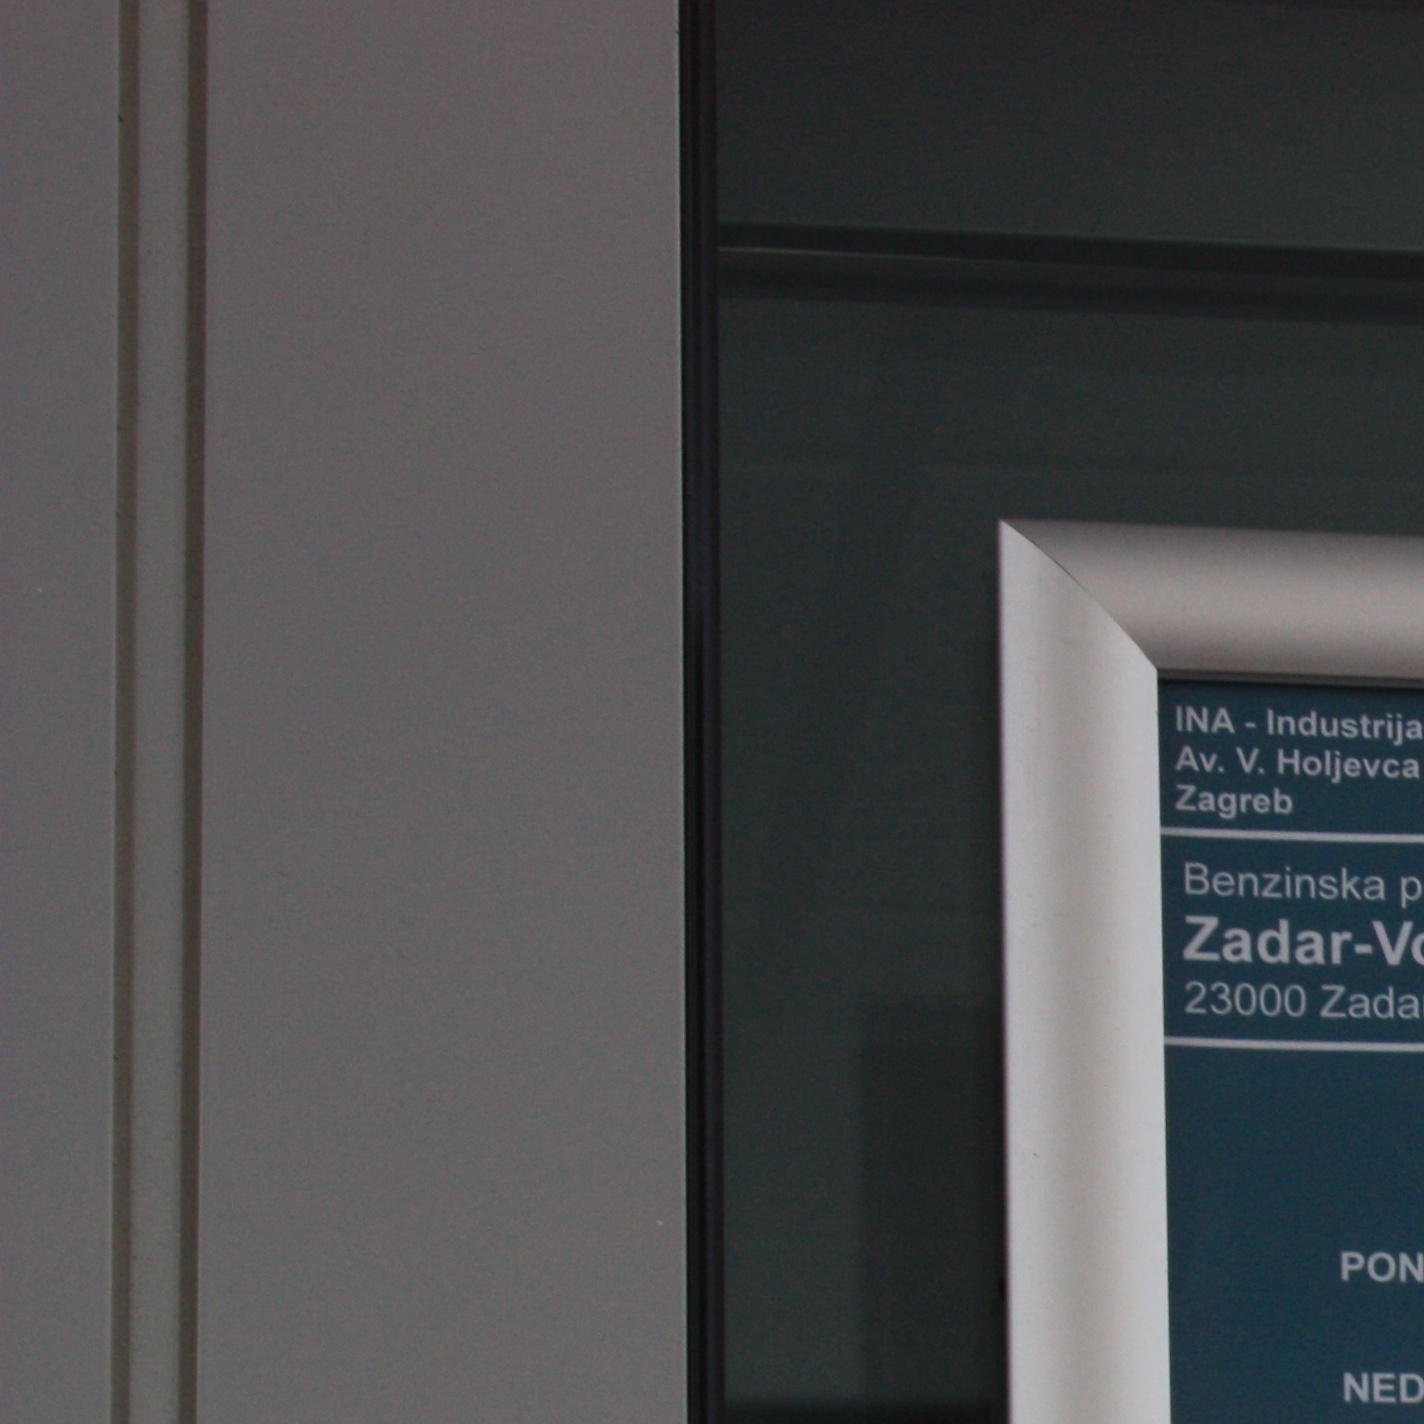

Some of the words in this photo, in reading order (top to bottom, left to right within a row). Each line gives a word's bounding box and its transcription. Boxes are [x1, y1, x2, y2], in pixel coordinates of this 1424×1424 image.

[1175, 706, 1235, 734] INA
[1267, 709, 1423, 745] Industrija
[1175, 746, 1225, 773] Av.
[1236, 747, 1265, 774] V.
[1277, 750, 1420, 783] Holjevca
[1175, 785, 1293, 819] Zagreb
[1183, 862, 1386, 901] Benzinska
[1184, 980, 1307, 1016] 23000
